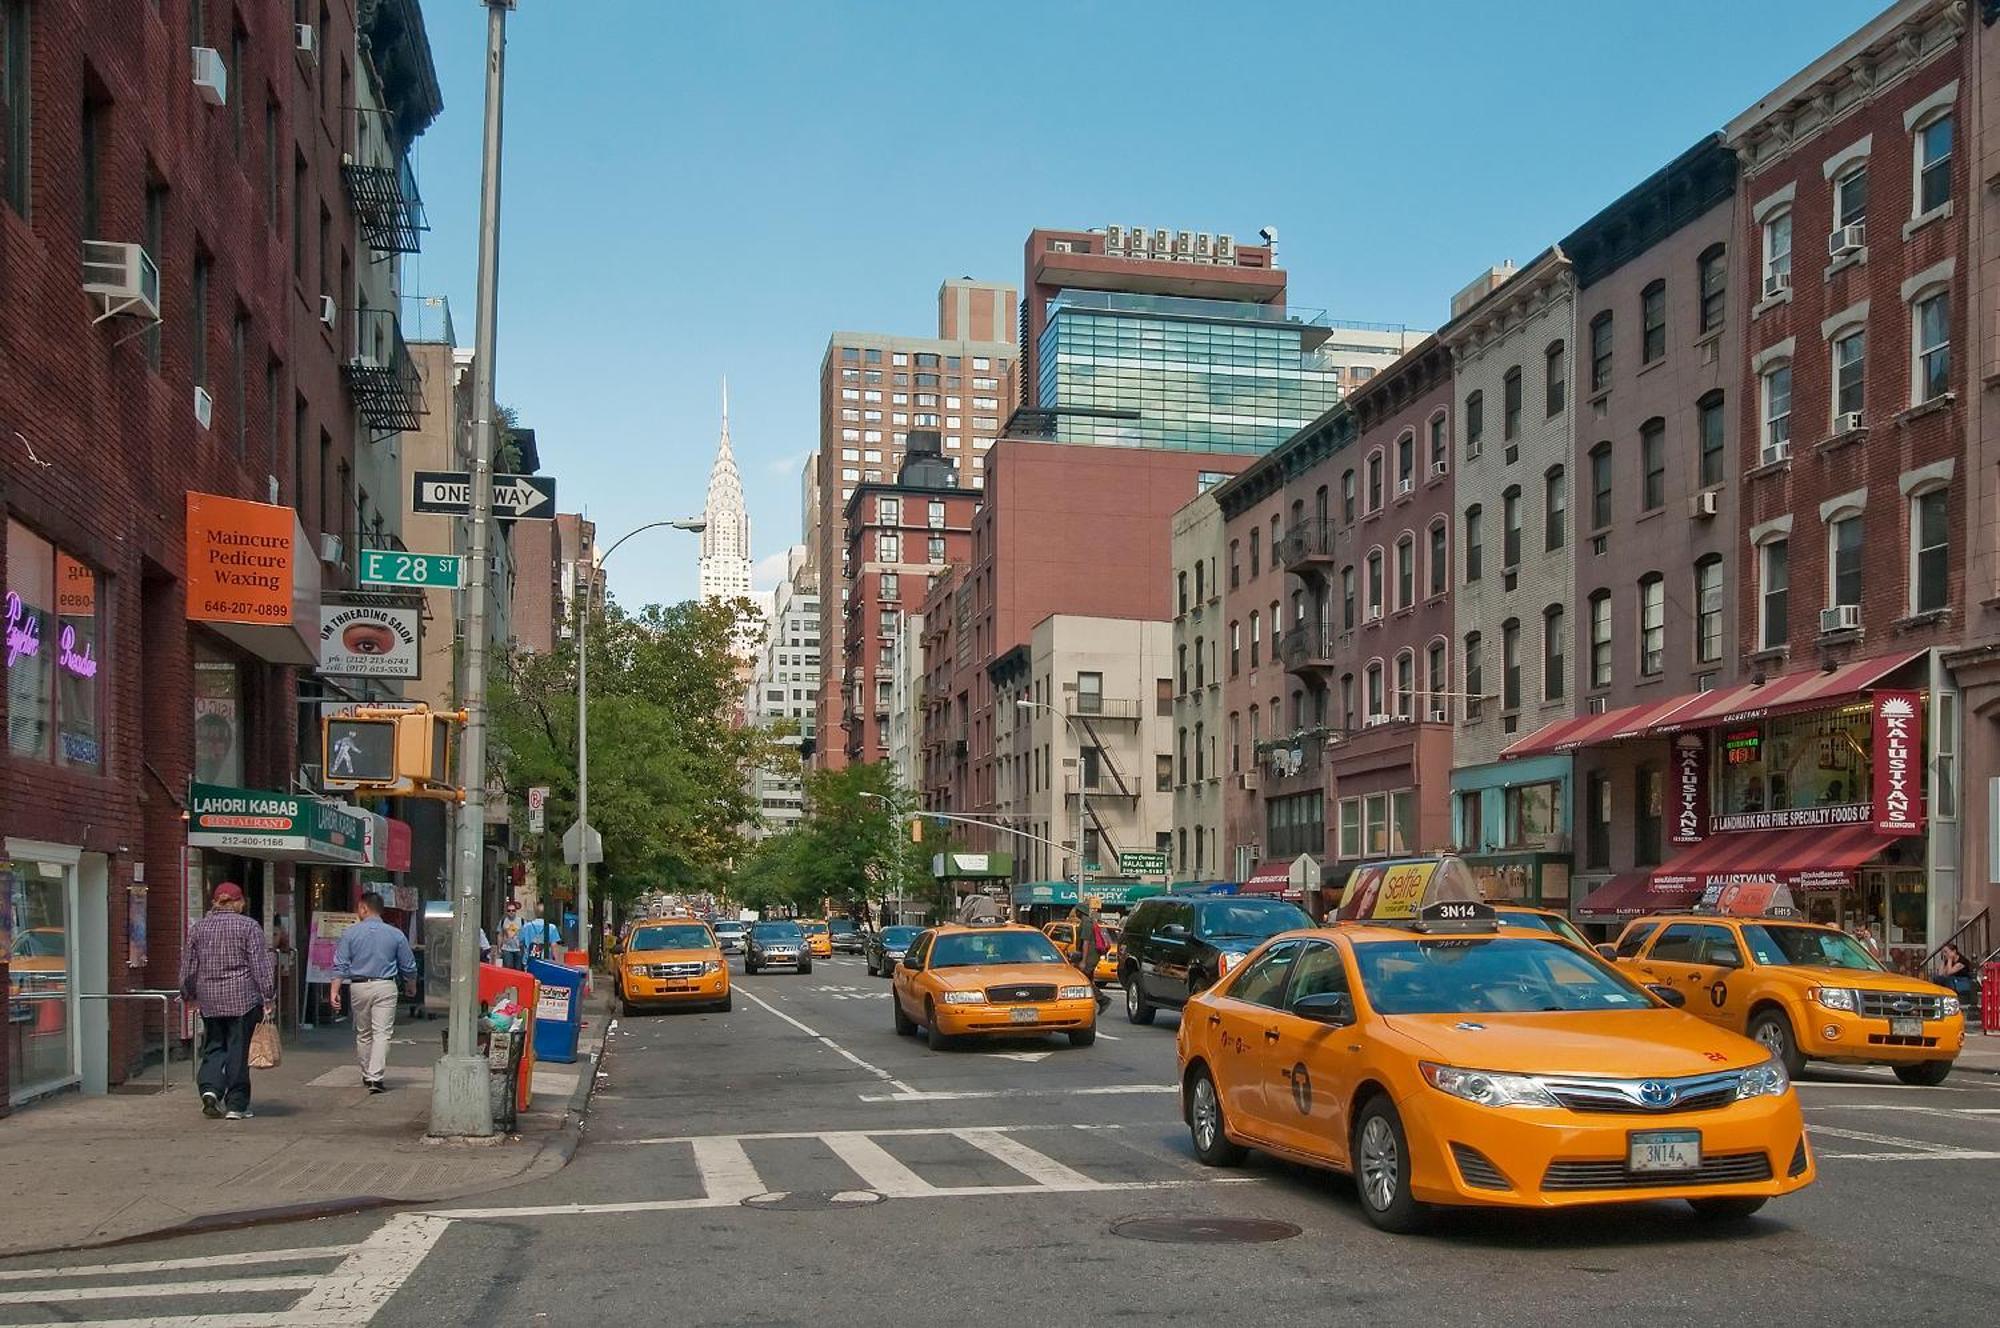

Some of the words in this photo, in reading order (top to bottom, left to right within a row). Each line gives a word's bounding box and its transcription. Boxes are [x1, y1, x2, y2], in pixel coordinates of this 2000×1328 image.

[434, 484, 470, 502] ONE
[493, 489, 534, 505] WAY
[207, 529, 290, 549] Maincure
[209, 549, 286, 569] Pedicure
[369, 555, 383, 580] E
[396, 556, 428, 582] 28
[440, 560, 453, 573] ST
[214, 569, 281, 592] Waxing
[204, 600, 288, 617] 646-207-0899
[330, 608, 388, 628] THREADING
[388, 617, 415, 645] SALON
[1886, 718, 1909, 821] KALUSTYANS
[1680, 750, 1698, 836] KALUSTYANS
[194, 798, 245, 812] LAHORI
[250, 800, 298, 816] KABAB
[207, 816, 286, 828] RESTAURANT
[1720, 815, 1755, 830] LANDMARK
[1757, 813, 1770, 828] FOR
[1772, 812, 1788, 826] FINE
[1790, 808, 1829, 826] SPECIALTY
[1831, 806, 1858, 822] FOODS
[1860, 806, 1870, 820] OF
[1061, 891, 1123, 900] LANDRY
[1440, 905, 1476, 918] 3N14
